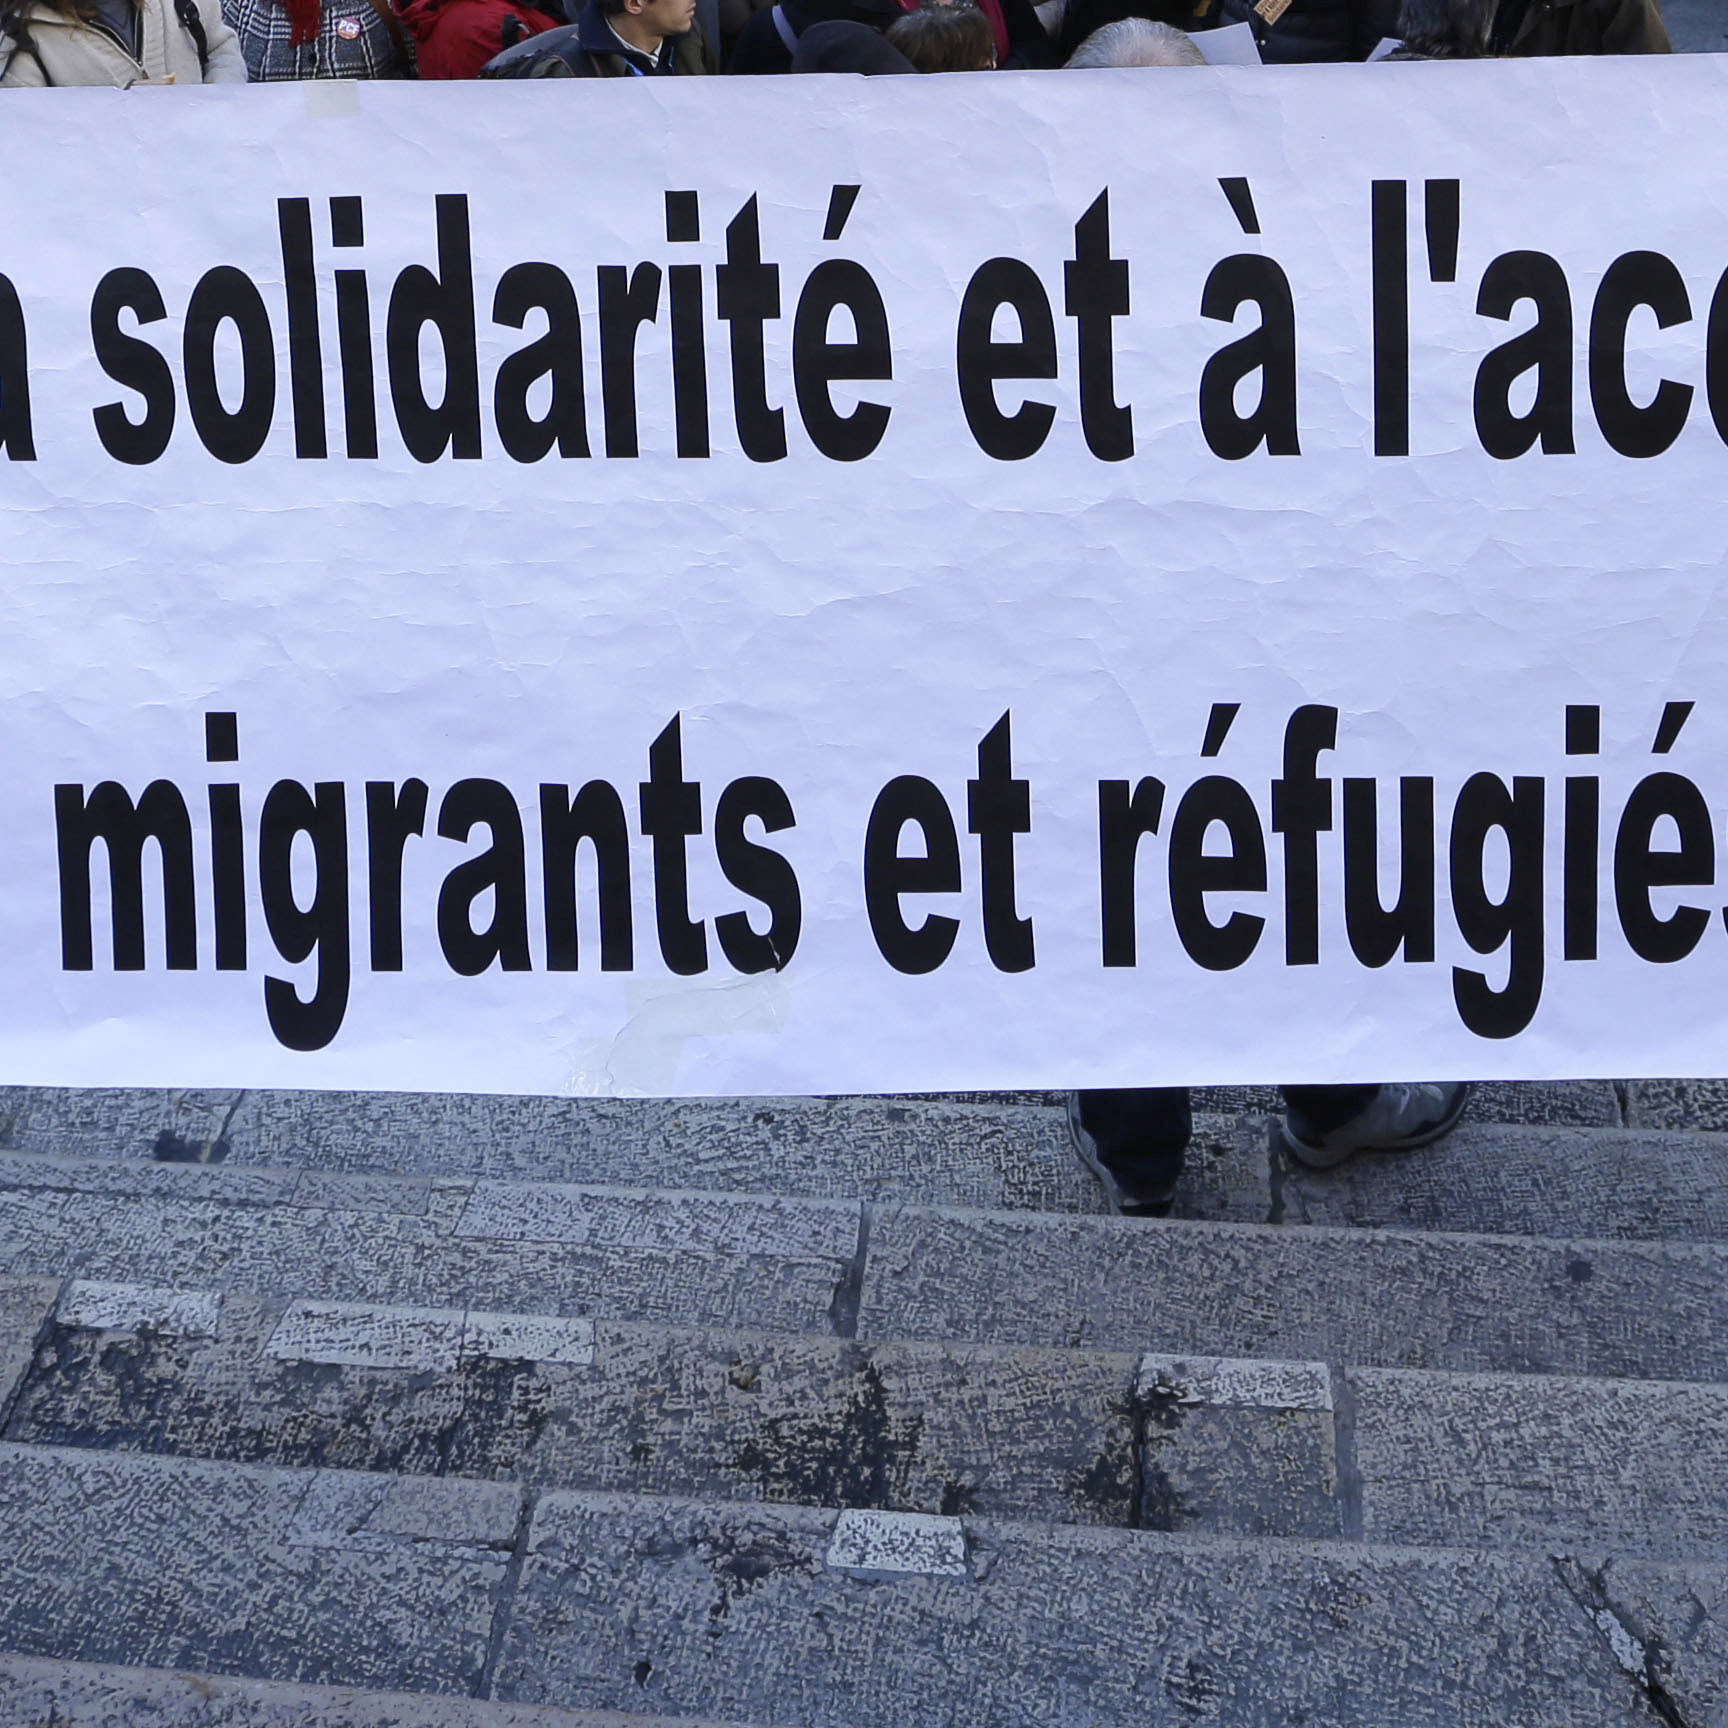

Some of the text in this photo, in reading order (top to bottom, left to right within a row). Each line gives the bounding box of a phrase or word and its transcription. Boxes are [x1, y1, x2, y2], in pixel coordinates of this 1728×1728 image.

[90, 184, 893, 466] solidarité
[957, 186, 1135, 462] et
[1200, 177, 1301, 461] à
[55, 711, 802, 1052] migrants
[863, 708, 1036, 975] et
